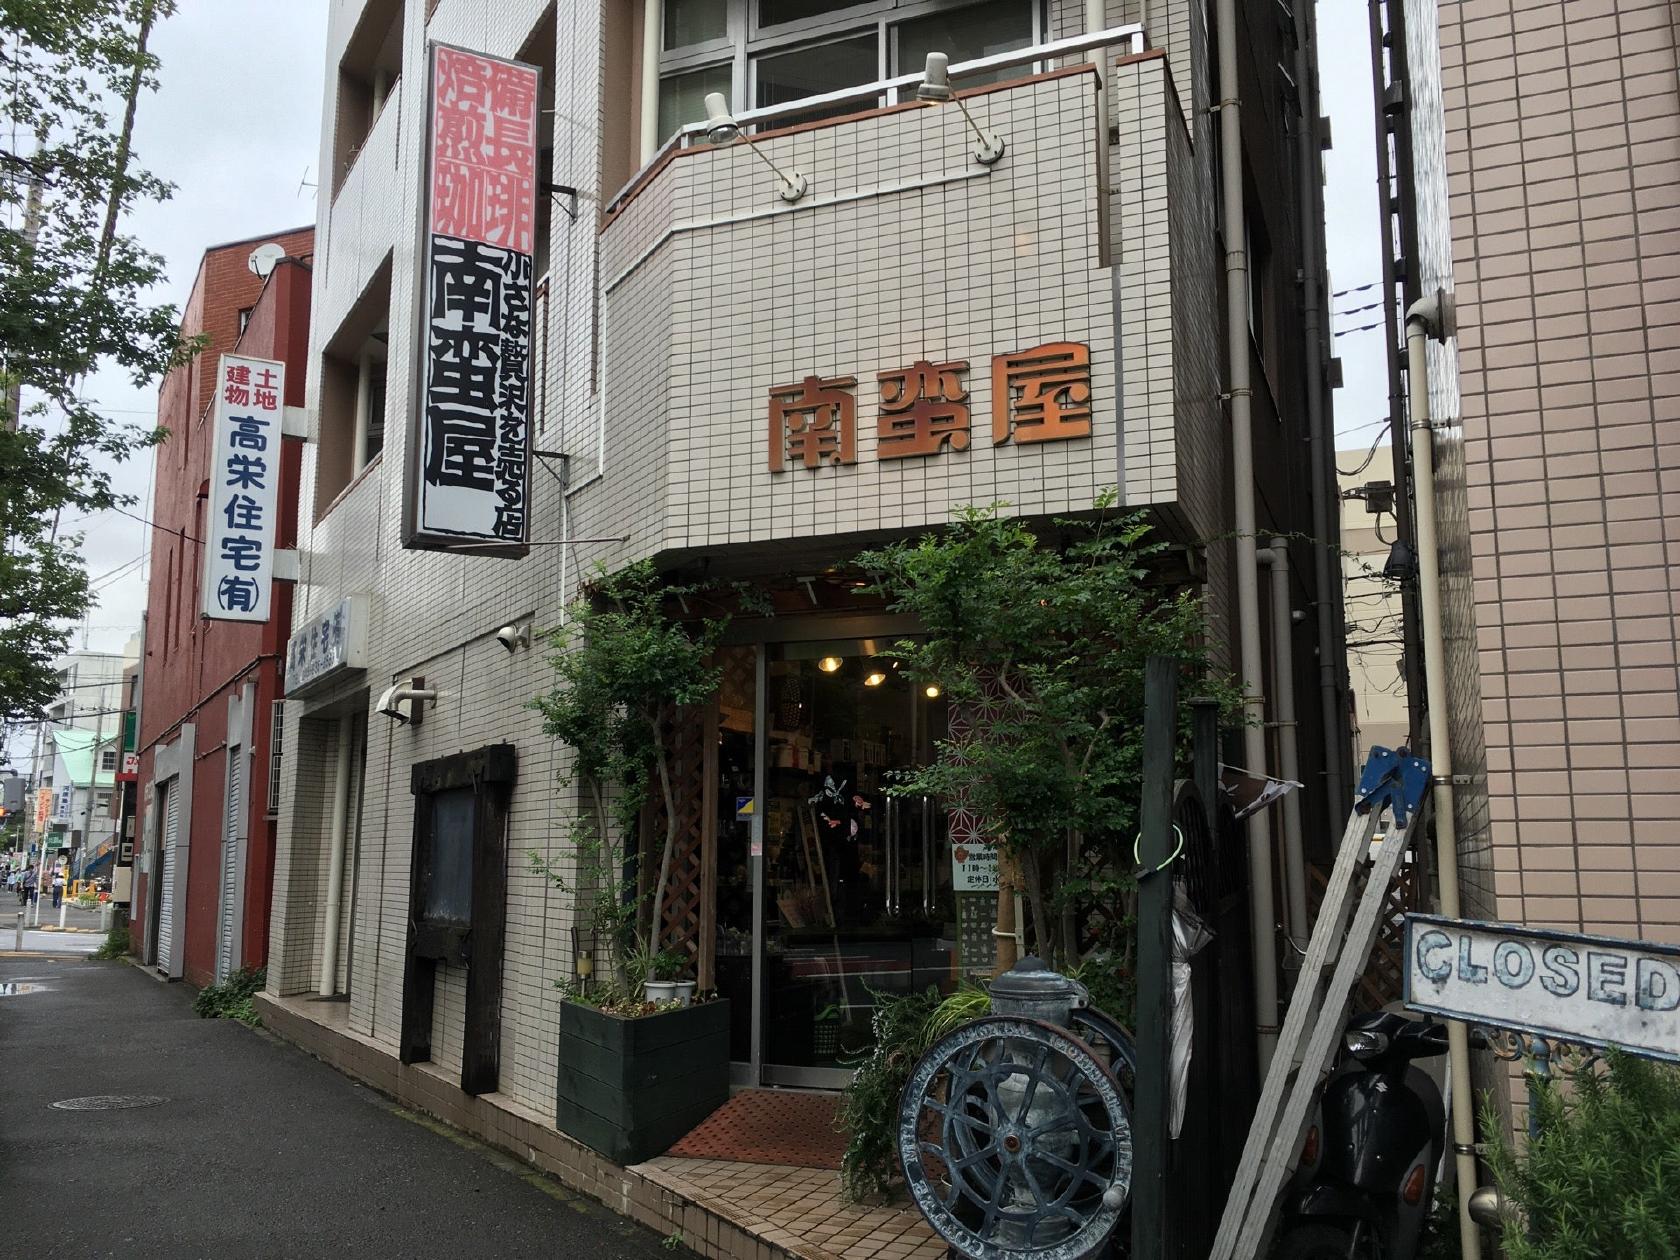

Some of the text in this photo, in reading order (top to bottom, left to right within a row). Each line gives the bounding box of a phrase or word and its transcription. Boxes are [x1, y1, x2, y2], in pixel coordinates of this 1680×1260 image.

[433, 158, 535, 255] 珈琲
[224, 365, 251, 407] 建物
[253, 368, 278, 411] 土地
[427, 236, 501, 492] 南蛮屋
[494, 249, 531, 540] 小さな贅沢を売る店
[768, 341, 1091, 473] 南蛮屋
[1416, 929, 1680, 1012] CLOSED
